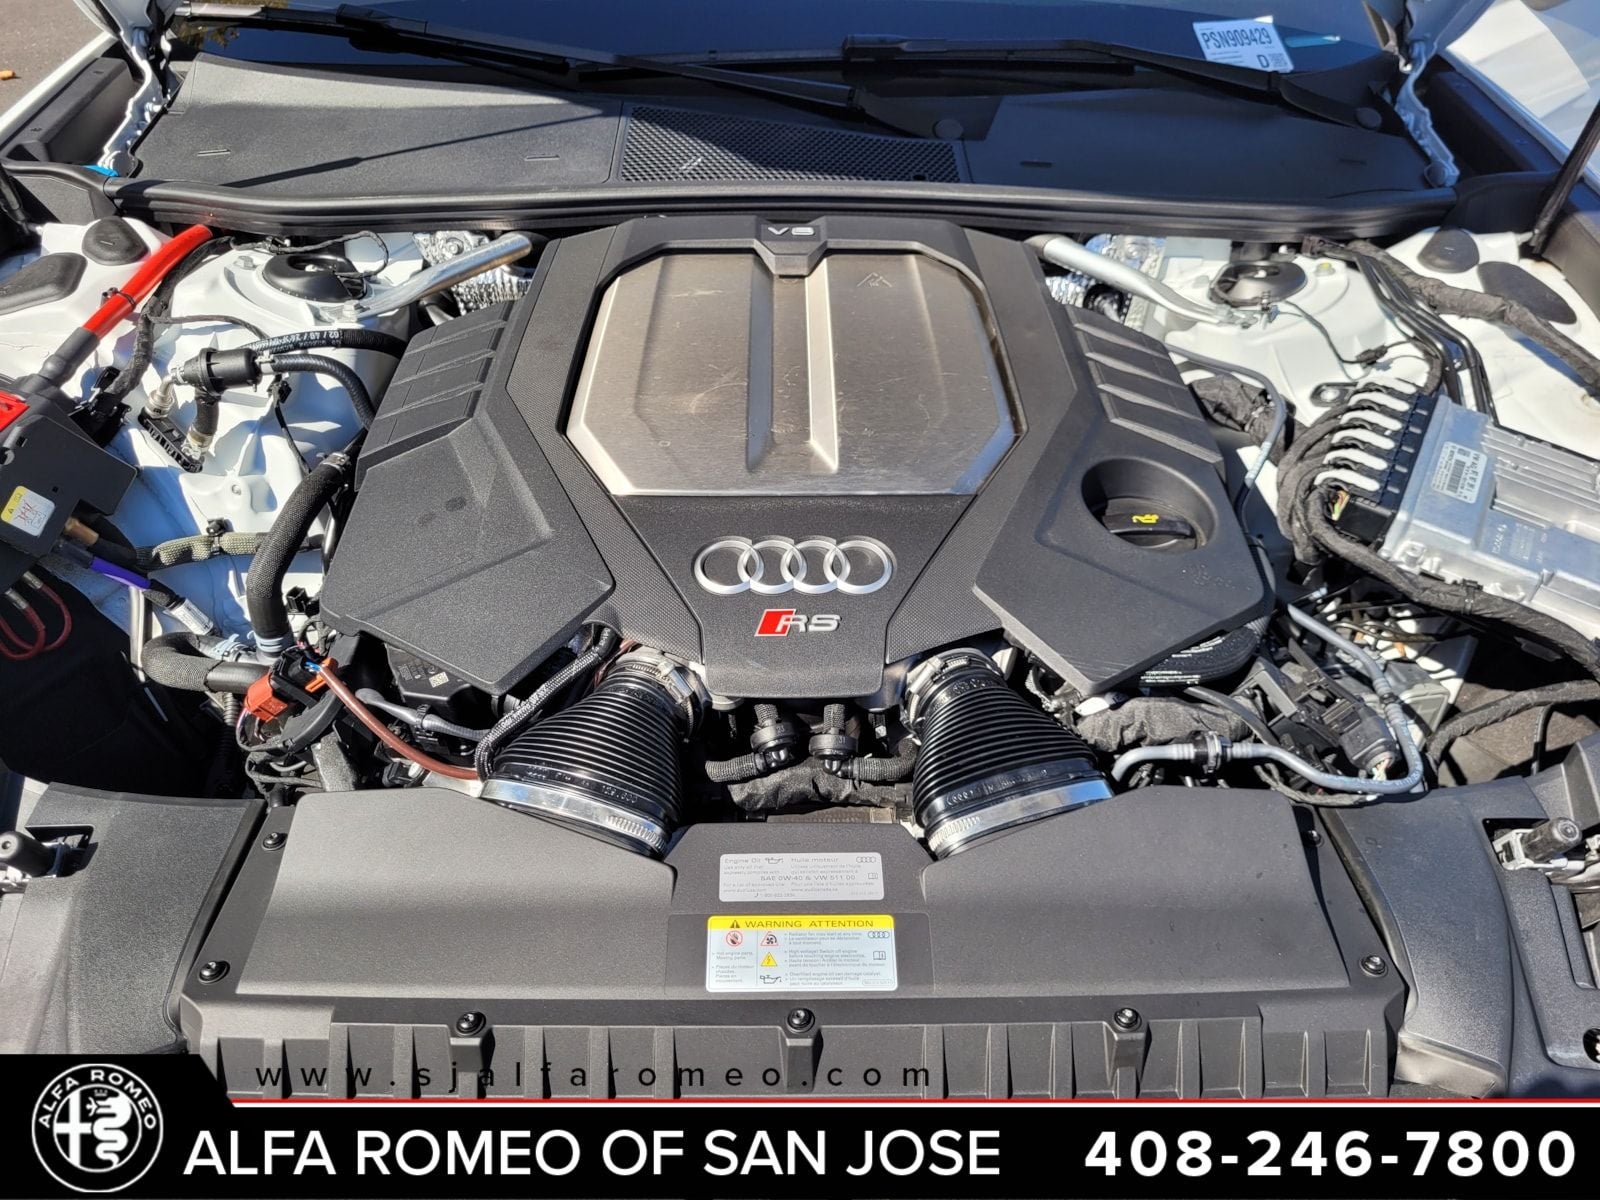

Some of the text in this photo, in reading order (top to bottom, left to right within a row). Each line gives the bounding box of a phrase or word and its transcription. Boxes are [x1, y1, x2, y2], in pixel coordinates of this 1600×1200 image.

[1200, 27, 1273, 50] PSN909429
[1256, 54, 1270, 69] D
[774, 614, 842, 633] RS
[745, 919, 874, 928] WARNING ATTENTION
